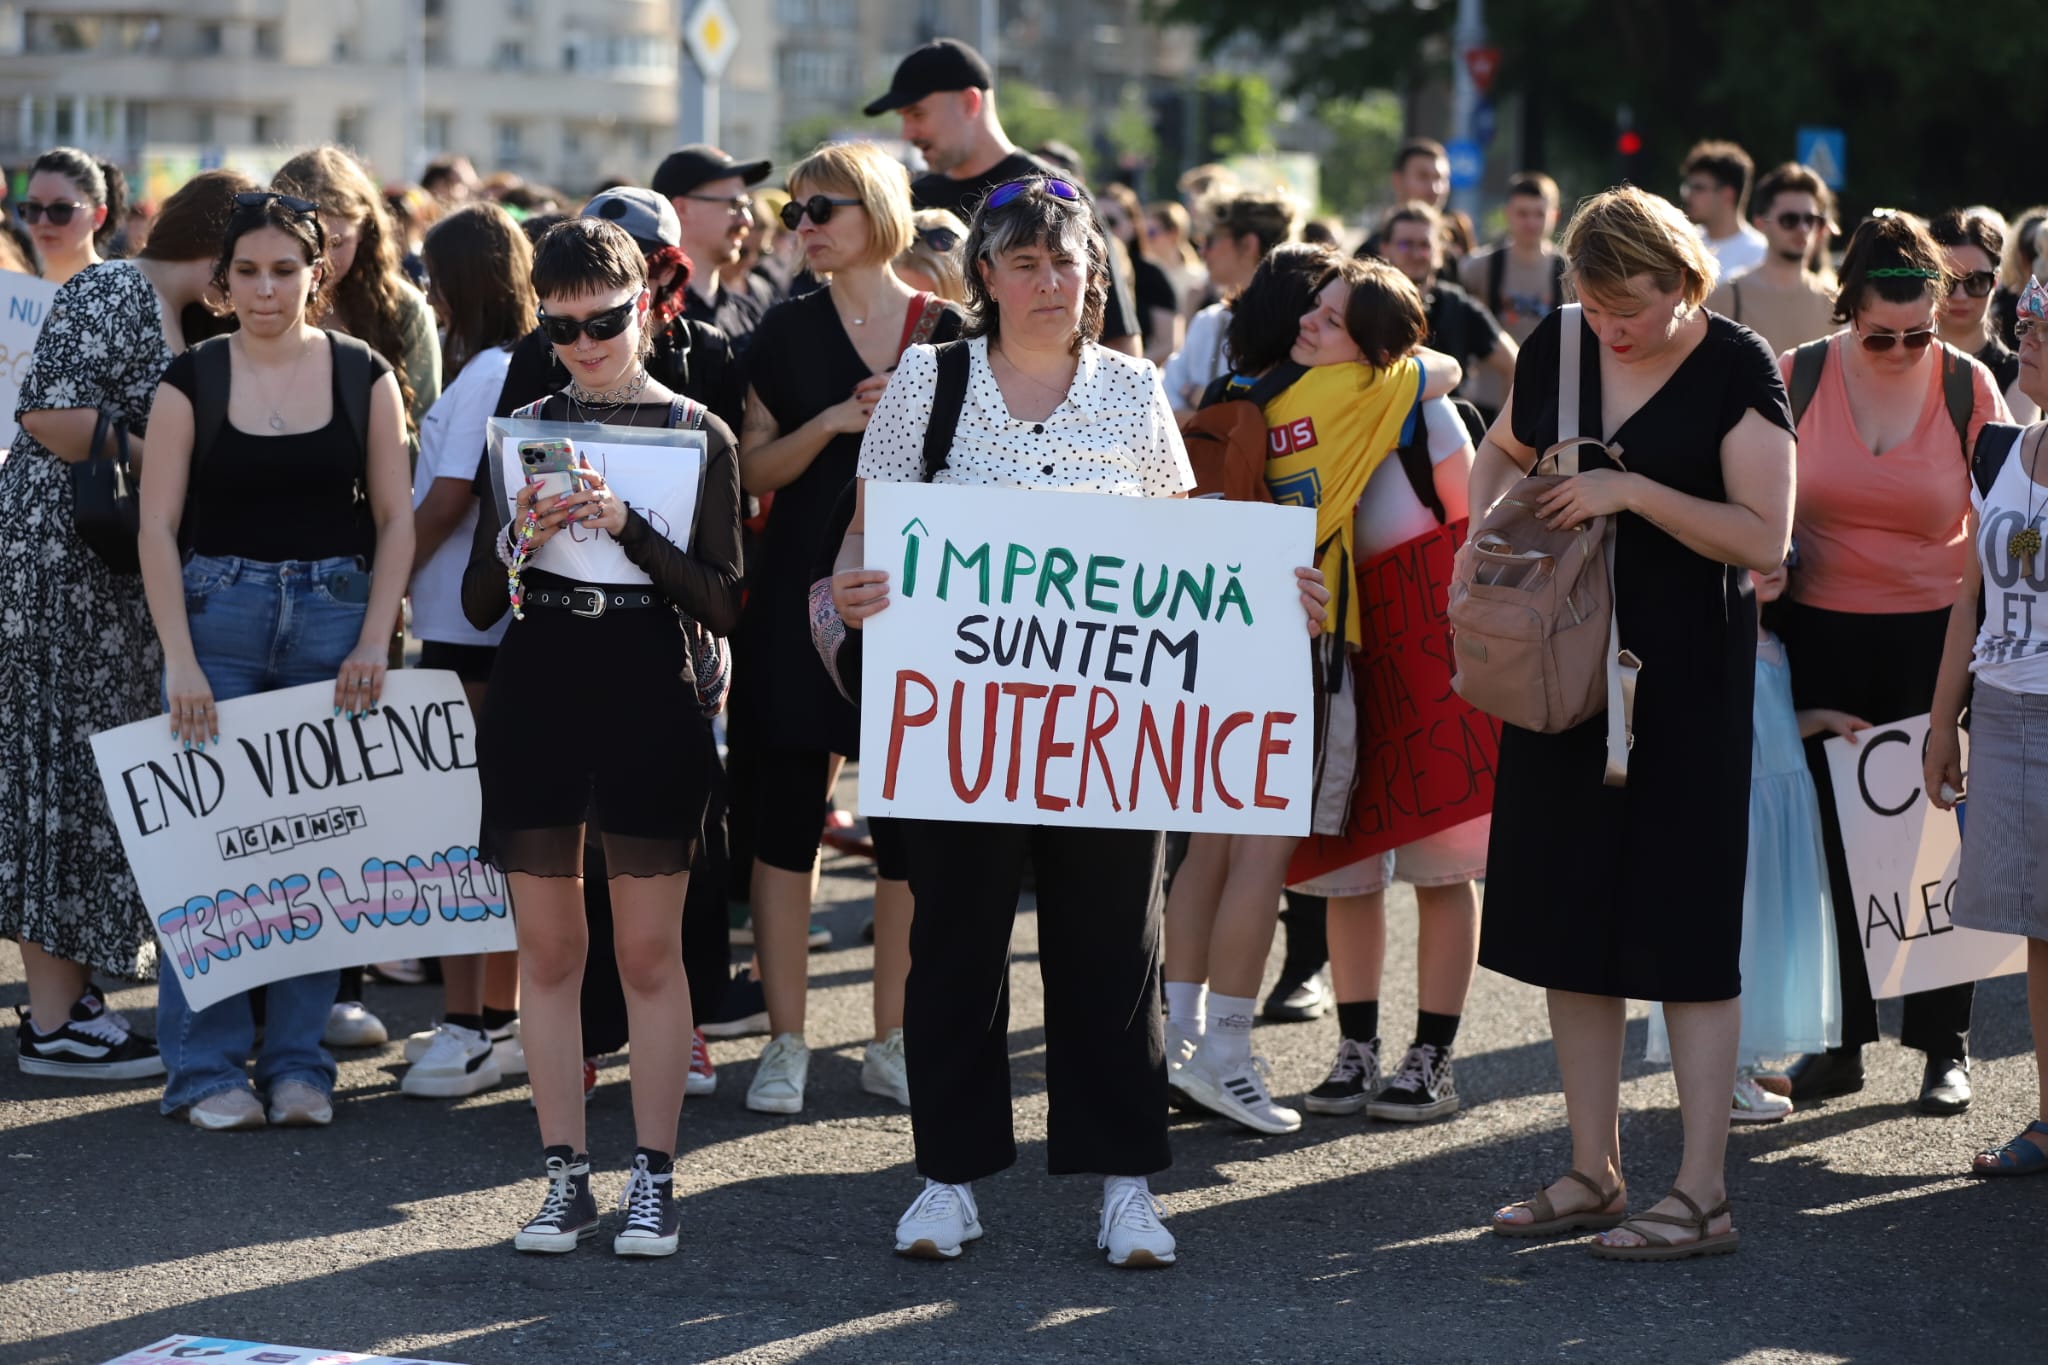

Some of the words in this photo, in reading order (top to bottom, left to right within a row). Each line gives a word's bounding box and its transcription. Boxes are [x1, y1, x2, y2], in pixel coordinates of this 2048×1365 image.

[9, 295, 43, 327] NU
[902, 517, 1254, 626] ÎMPREUNĂ
[955, 615, 1199, 693] SUNTEM
[121, 748, 225, 837] END
[237, 700, 478, 798] VIOLENCE
[882, 669, 1298, 814] PUTERNICE
[223, 808, 361, 858] AGAINST
[158, 873, 322, 980] TRANS
[318, 845, 506, 934] WOMEN
